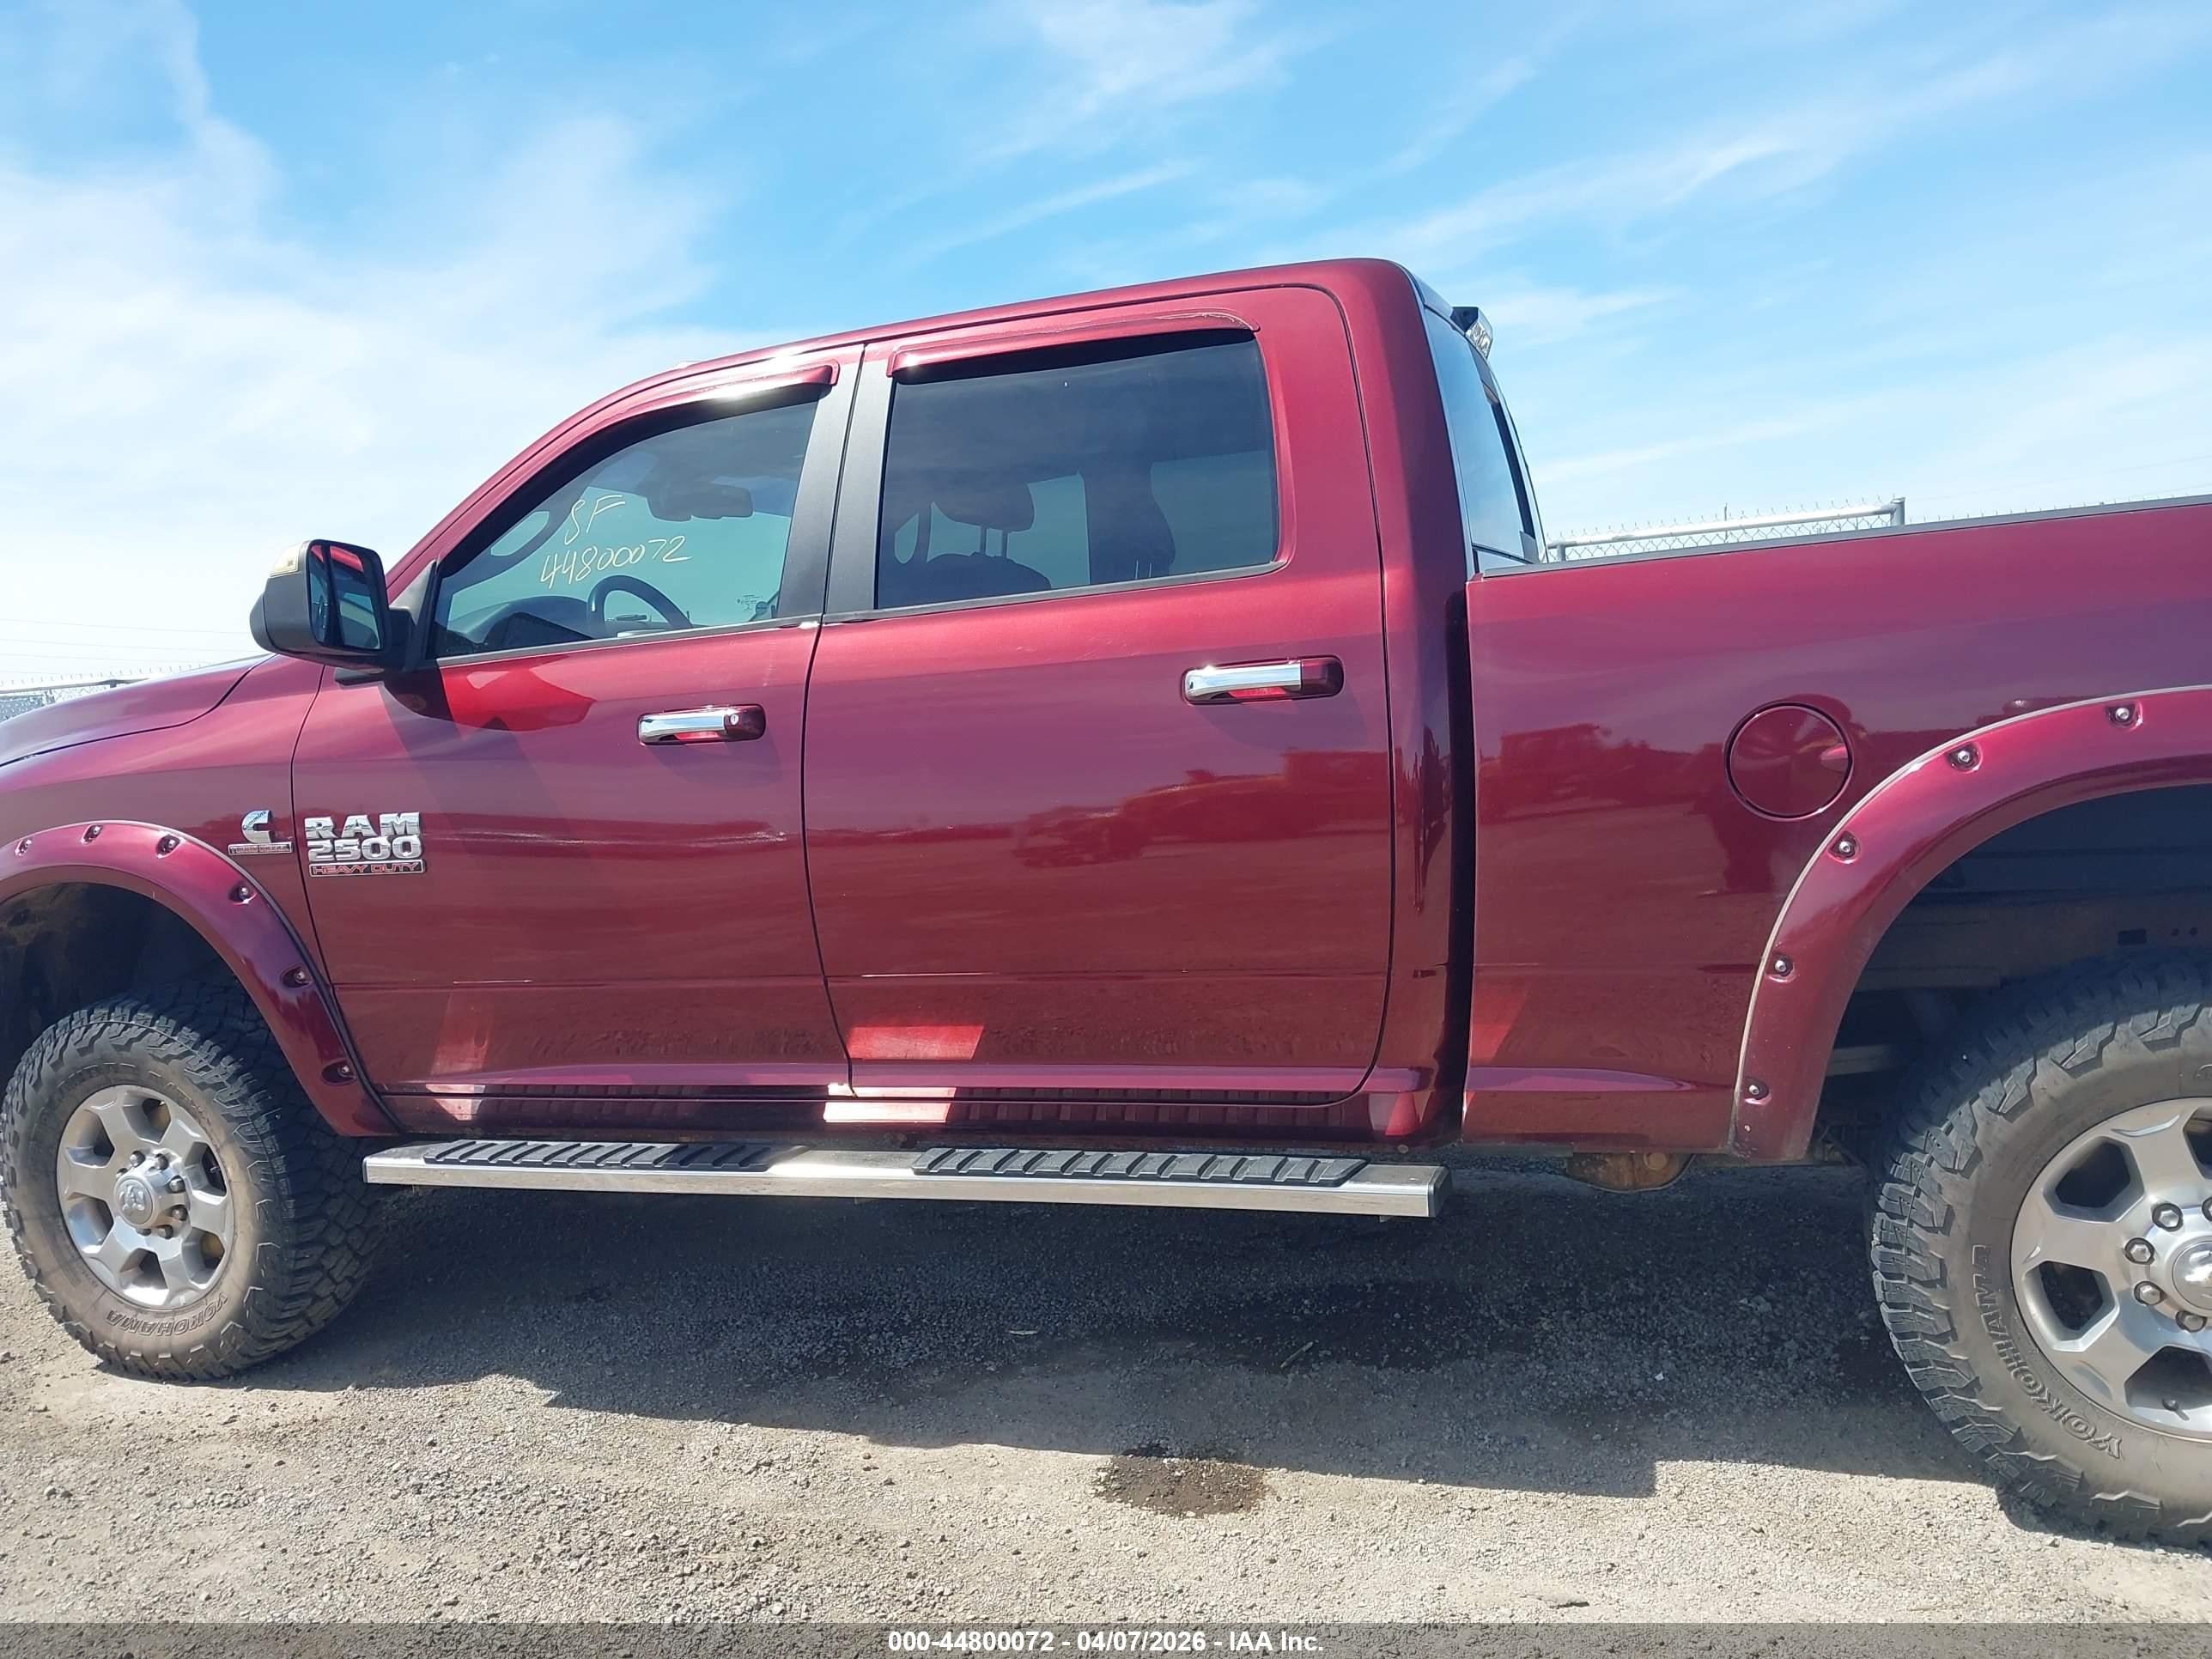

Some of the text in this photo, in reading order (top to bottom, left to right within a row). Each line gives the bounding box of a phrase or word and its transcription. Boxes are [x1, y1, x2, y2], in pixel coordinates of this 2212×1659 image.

[564, 494, 626, 545] SF
[540, 535, 692, 589] 44800072
[304, 811, 421, 839] RAM
[307, 835, 422, 862] 2500
[313, 861, 419, 875] HEAVY DUTY
[106, 1292, 228, 1337] YOKOHAMA
